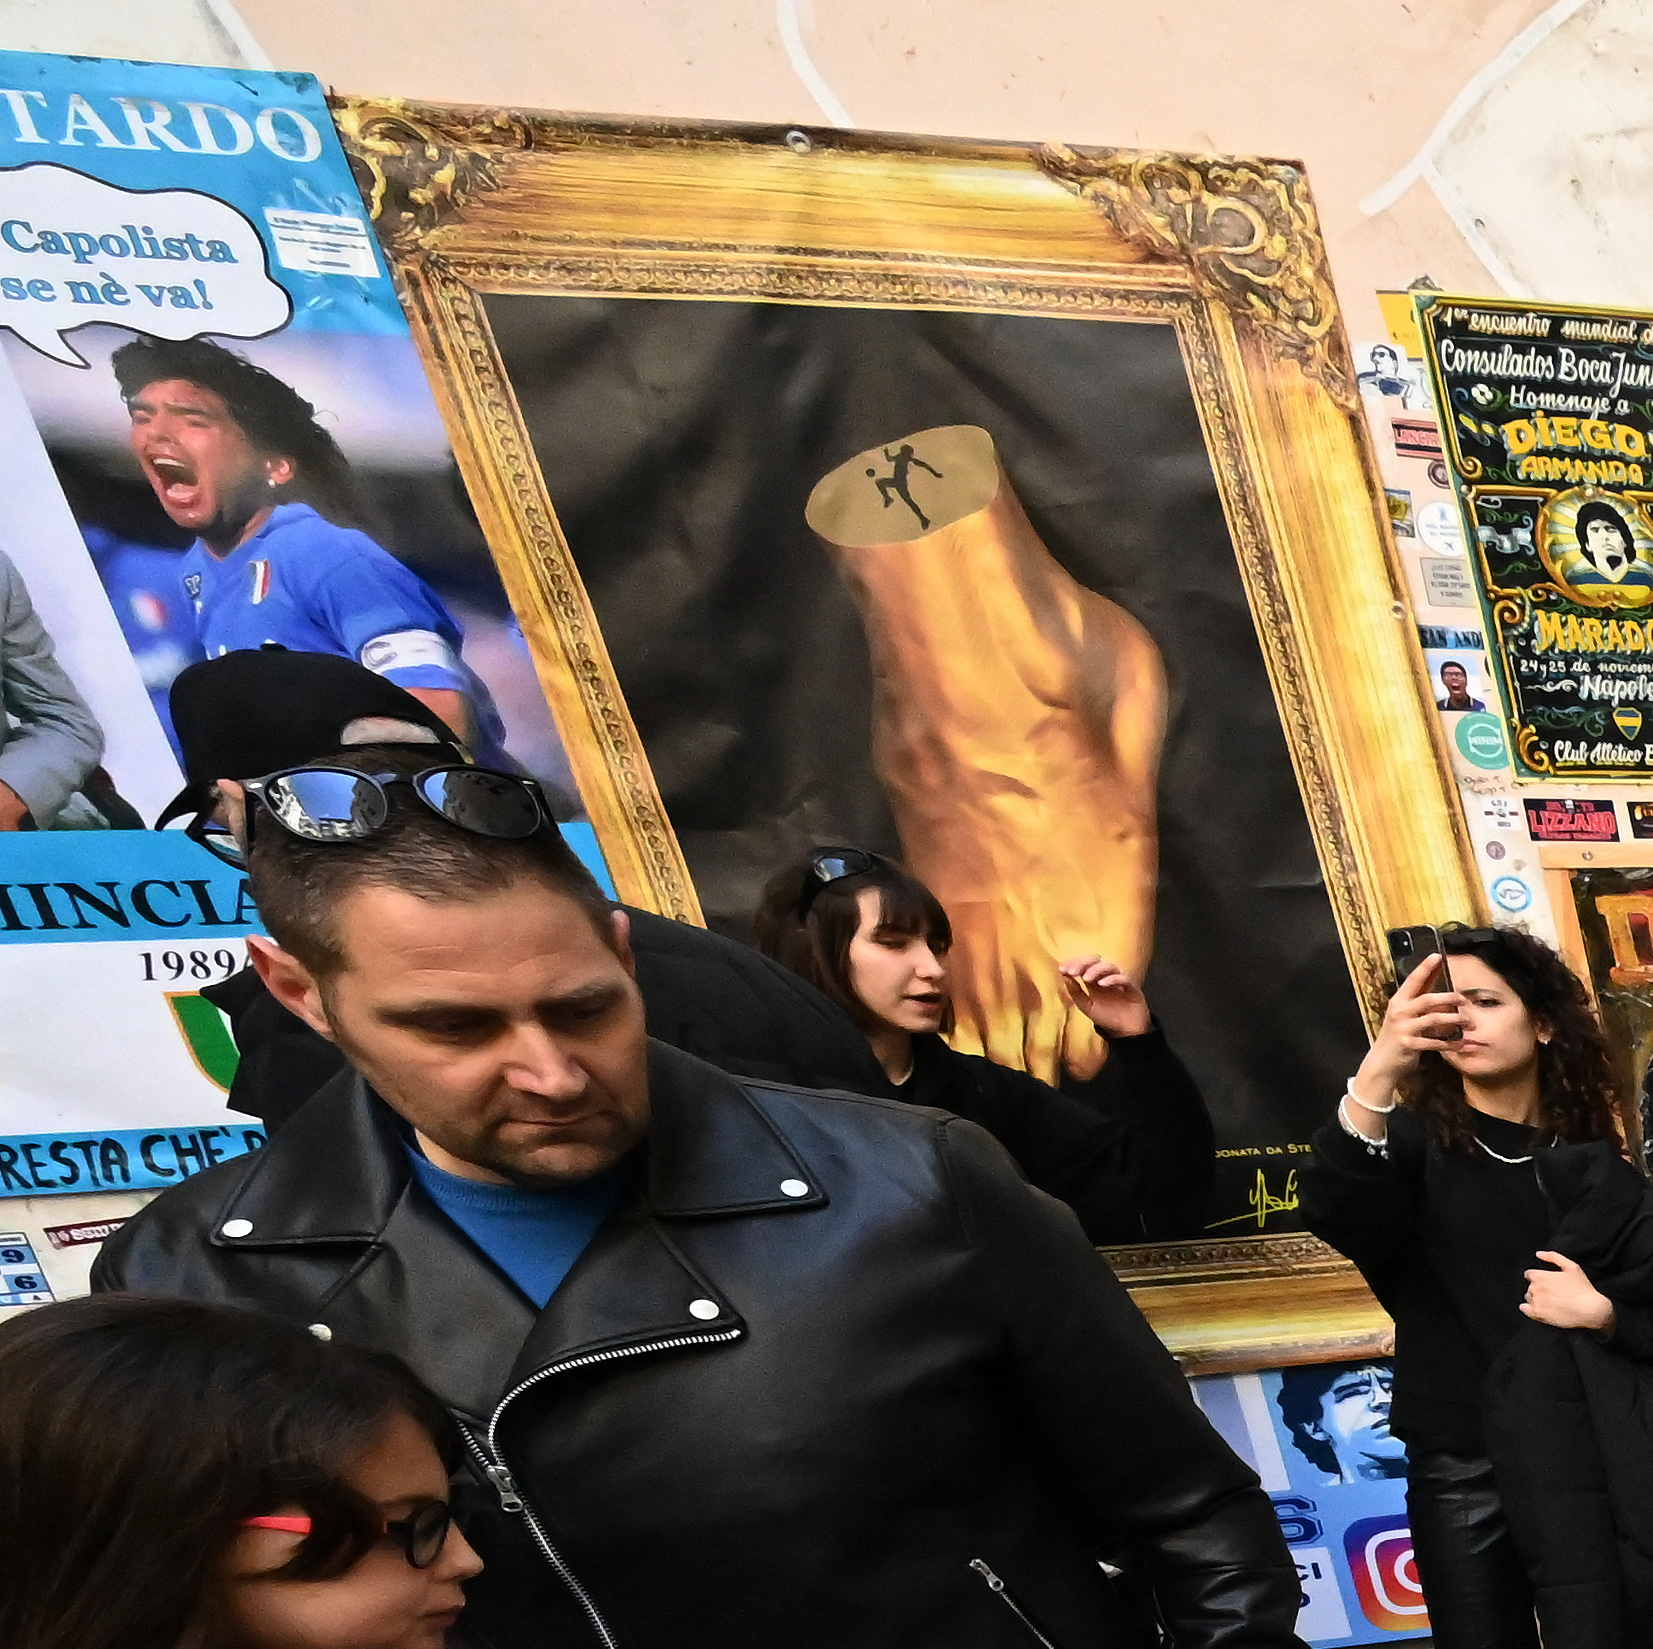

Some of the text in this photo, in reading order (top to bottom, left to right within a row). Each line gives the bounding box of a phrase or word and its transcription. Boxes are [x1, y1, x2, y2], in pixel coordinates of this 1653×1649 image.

[1, 219, 238, 265] Capolista
[1, 280, 55, 305] se
[139, 279, 214, 311] va!
[1470, 312, 1551, 337] encuentro
[1560, 319, 1638, 341] mundial
[1440, 338, 1555, 381] Consulados
[1558, 347, 1614, 385] Boca
[1509, 384, 1630, 416] Homenaje a
[1503, 411, 1651, 456] DIEGO
[1520, 455, 1645, 485] ARMANDO
[1520, 660, 1538, 674] 24
[1548, 661, 1567, 674] 25
[1570, 660, 1590, 673] de
[1554, 741, 1589, 763] Club
